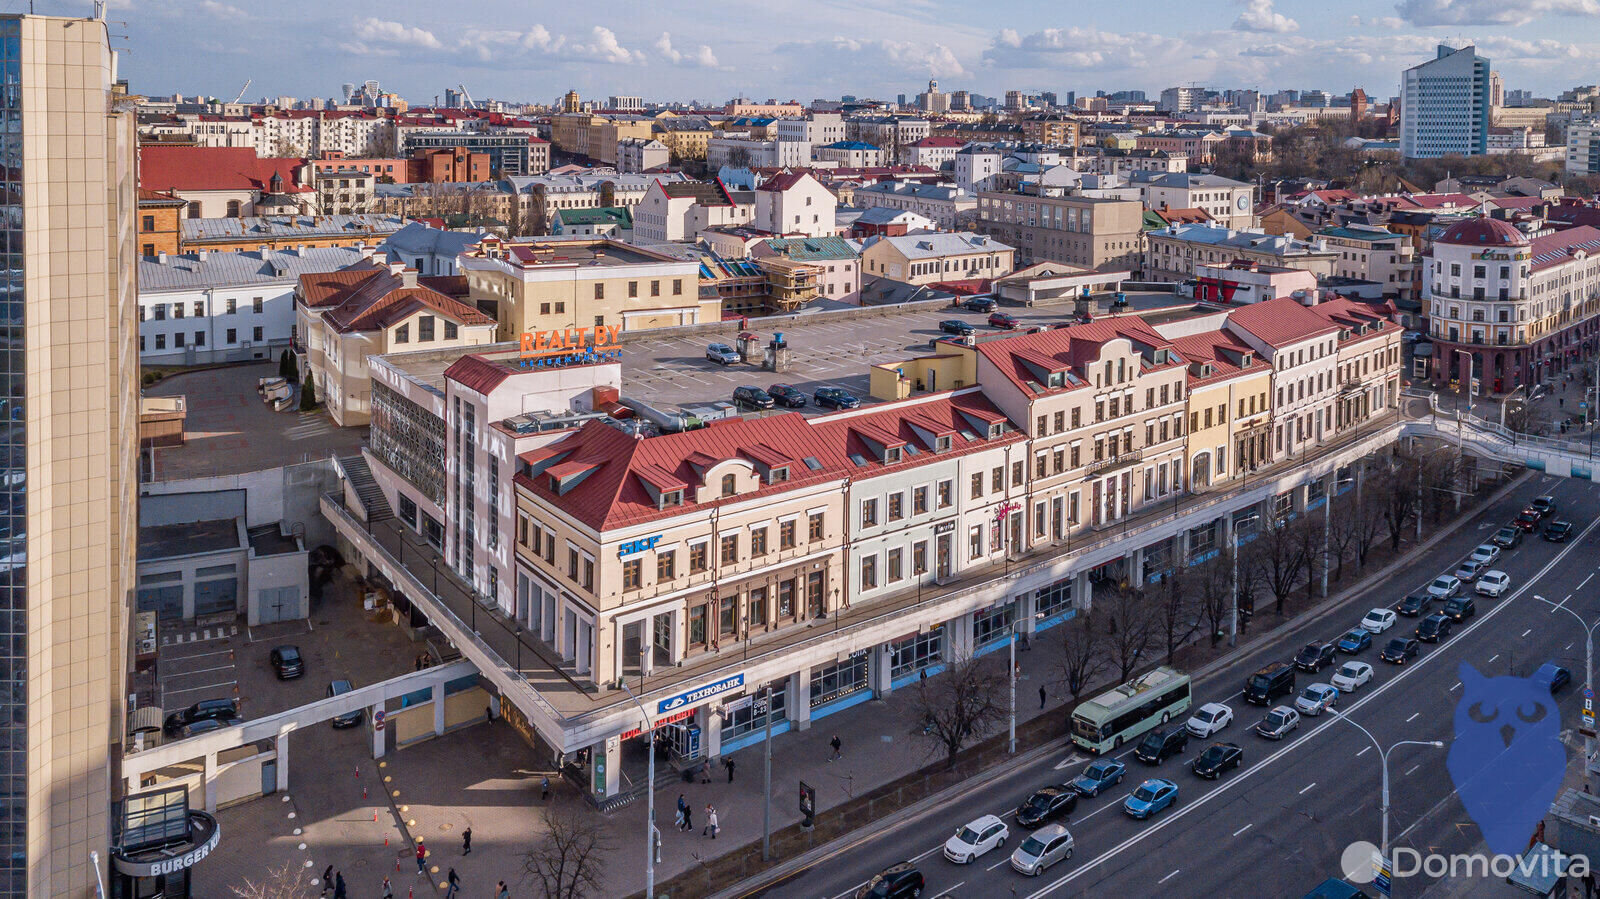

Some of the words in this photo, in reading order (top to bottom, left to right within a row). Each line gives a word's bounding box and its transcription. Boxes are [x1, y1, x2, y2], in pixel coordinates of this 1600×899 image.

[520, 351, 623, 368] НЕДВИЖИМОСТЬ
[619, 534, 663, 557] SKF
[686, 677, 741, 703] ТЕХНОБАНК
[150, 845, 210, 876] BURGER
